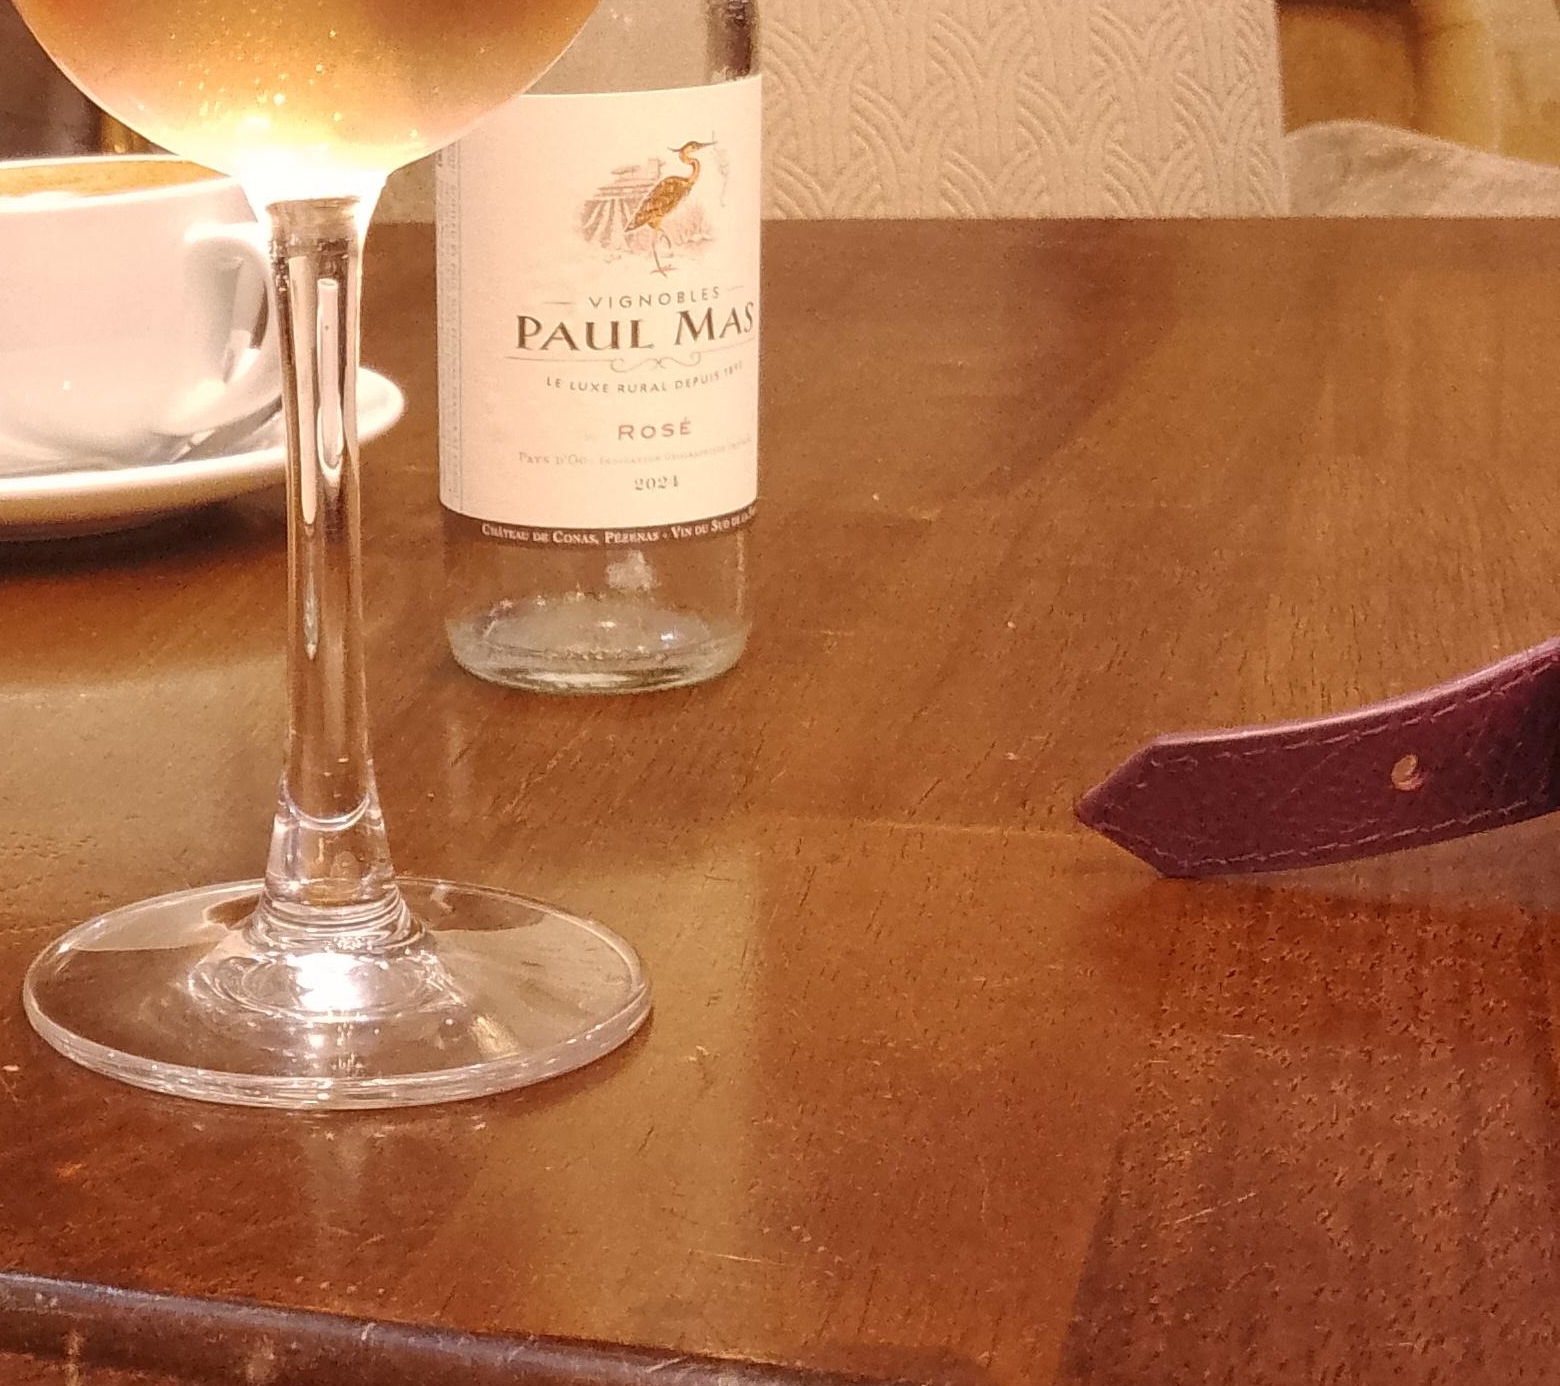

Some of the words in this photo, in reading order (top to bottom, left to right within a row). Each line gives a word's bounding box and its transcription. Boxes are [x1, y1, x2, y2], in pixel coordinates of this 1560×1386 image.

[588, 286, 720, 309] VIGNOBLES
[516, 315, 654, 351] PAUL
[674, 302, 754, 345] MAS
[546, 376, 562, 388] LE
[569, 380, 609, 393] LUXE
[618, 381, 666, 394] RURAL
[675, 371, 720, 390] DEPUIS
[618, 416, 692, 441] ROSÉ
[481, 523, 529, 541] CHÂTEAU
[532, 530, 549, 543] DE
[671, 524, 693, 540] VIN
[694, 523, 709, 535] DU
